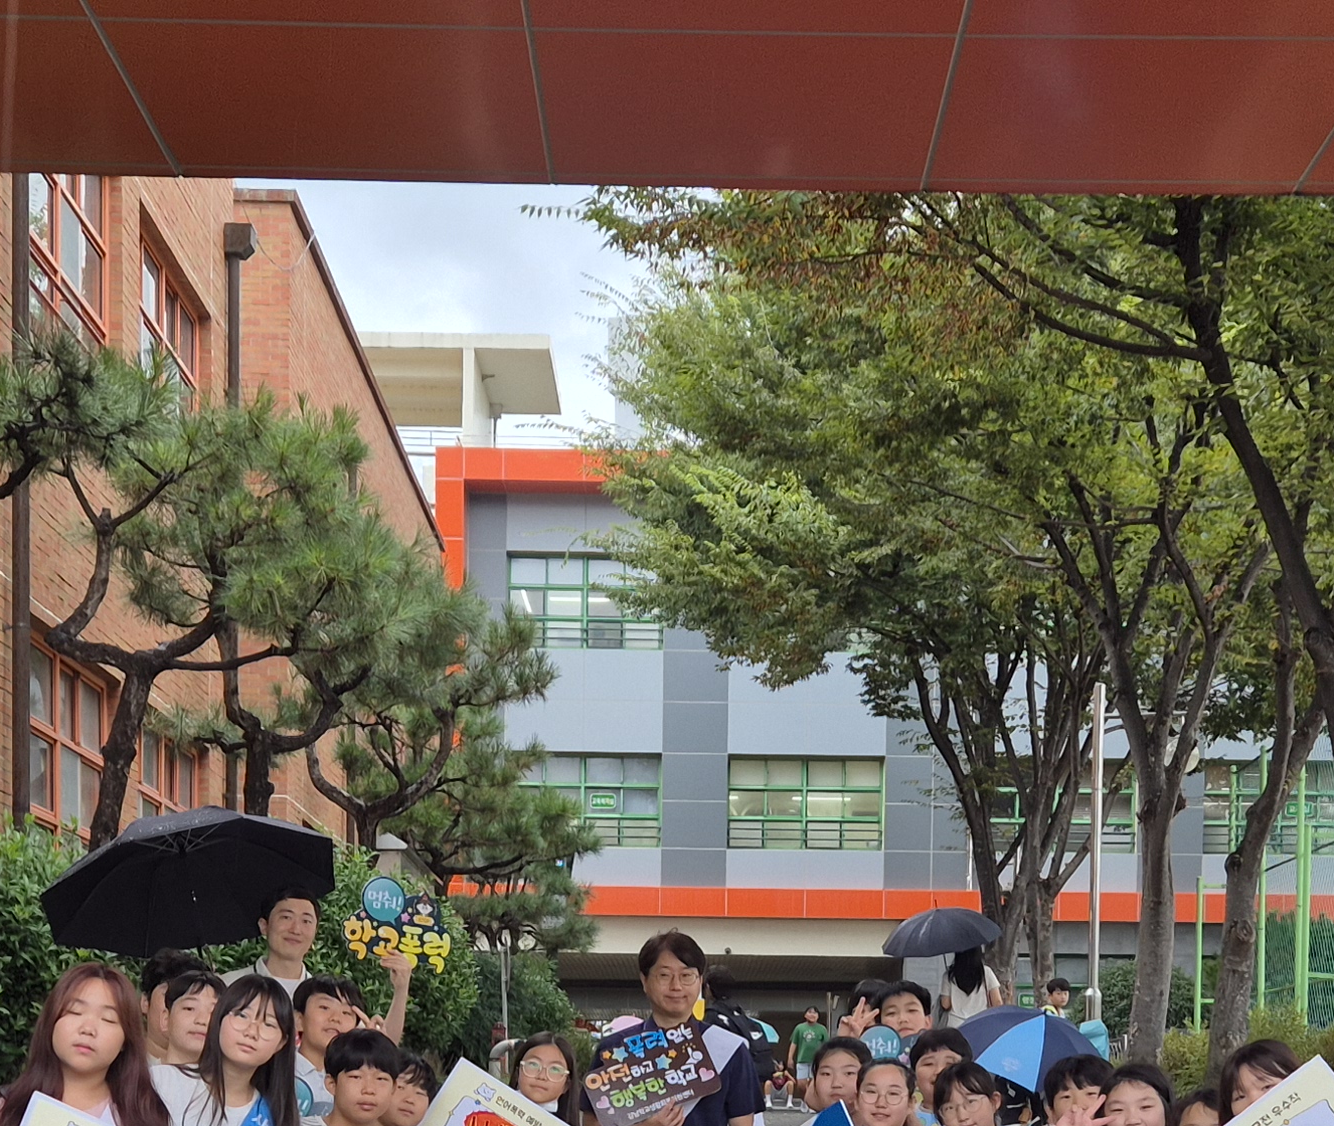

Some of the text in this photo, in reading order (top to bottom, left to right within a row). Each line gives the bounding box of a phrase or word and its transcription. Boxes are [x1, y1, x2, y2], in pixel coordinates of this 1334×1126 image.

[368, 890, 402, 912] 멈춰!
[624, 1023, 694, 1058] 폭력 없는
[610, 1064, 698, 1108] 행복한 학교
[495, 1095, 526, 1119] 언어폭력
[1271, 1092, 1302, 1117] 우수작
